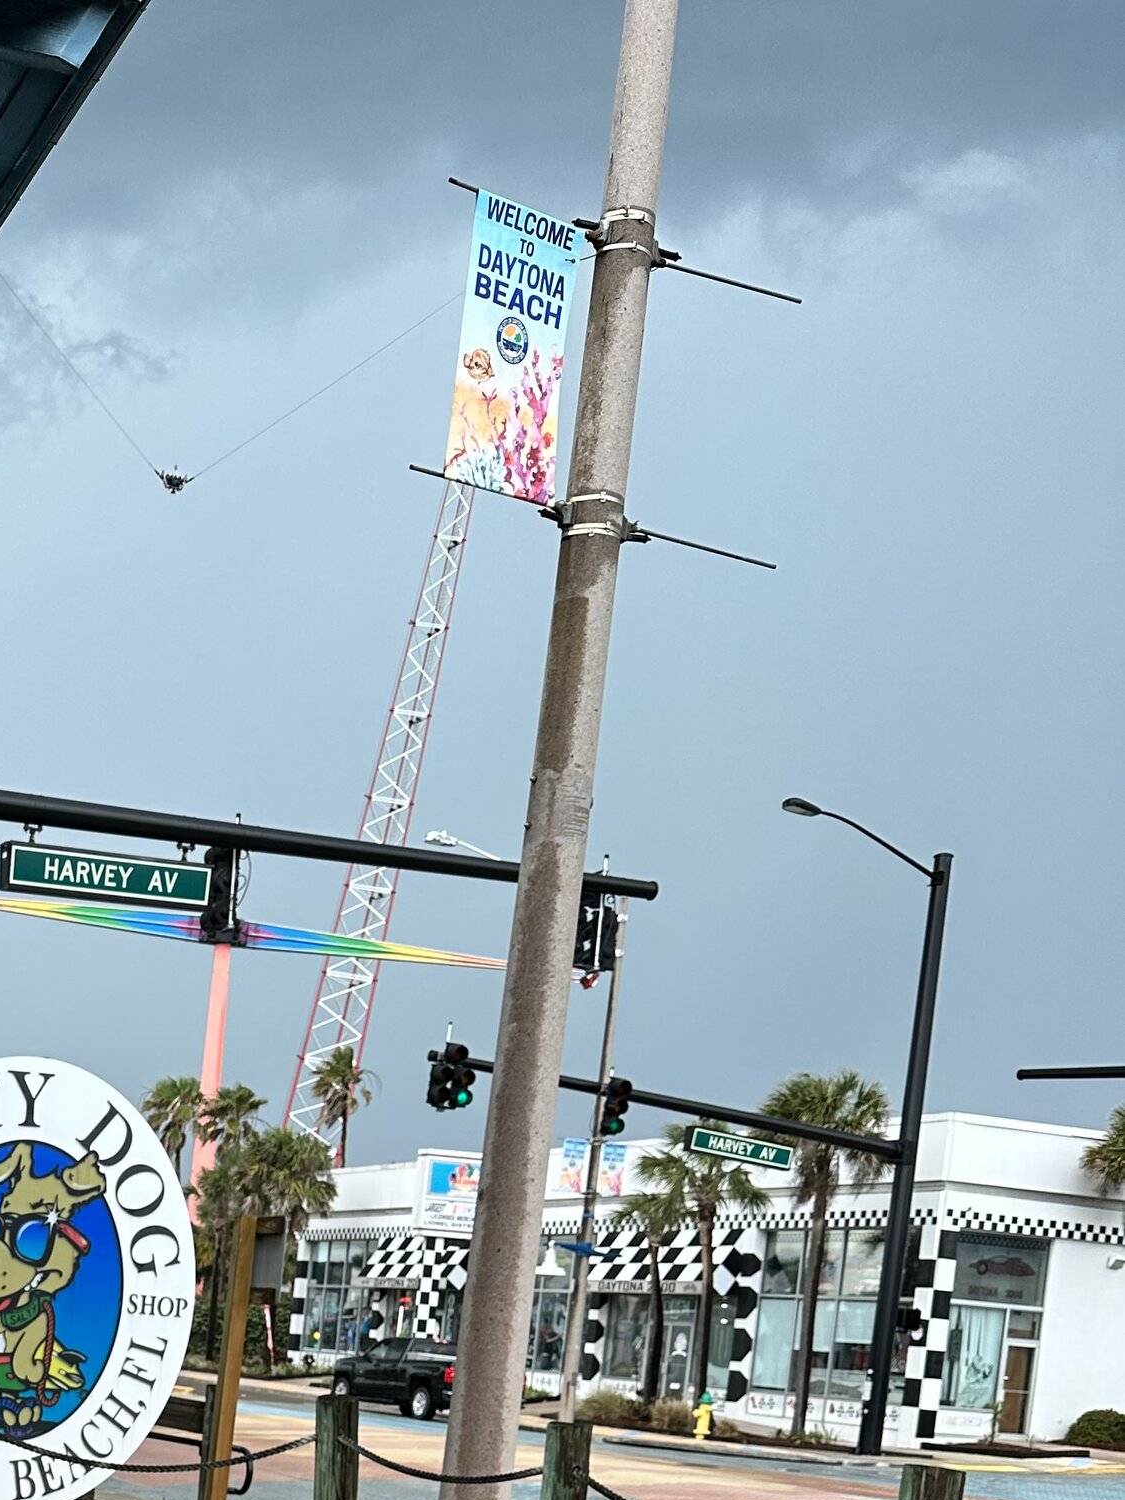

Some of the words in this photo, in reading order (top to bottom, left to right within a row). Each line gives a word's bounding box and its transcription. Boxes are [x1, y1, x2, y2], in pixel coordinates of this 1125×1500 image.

[487, 196, 576, 251] WELCOME
[520, 238, 534, 257] TO
[478, 243, 565, 301] DAYTONA
[474, 271, 563, 329] BEACH
[44, 857, 134, 888] HARVEY
[147, 870, 179, 893] AV
[707, 1135, 755, 1156] HARVEY
[759, 1148, 777, 1161] AV
[76, 1100, 182, 1279] DOG
[127, 1293, 188, 1319] SHOP
[598, 1281, 643, 1292] DAYTONA
[118, 1336, 168, 1390] FL
